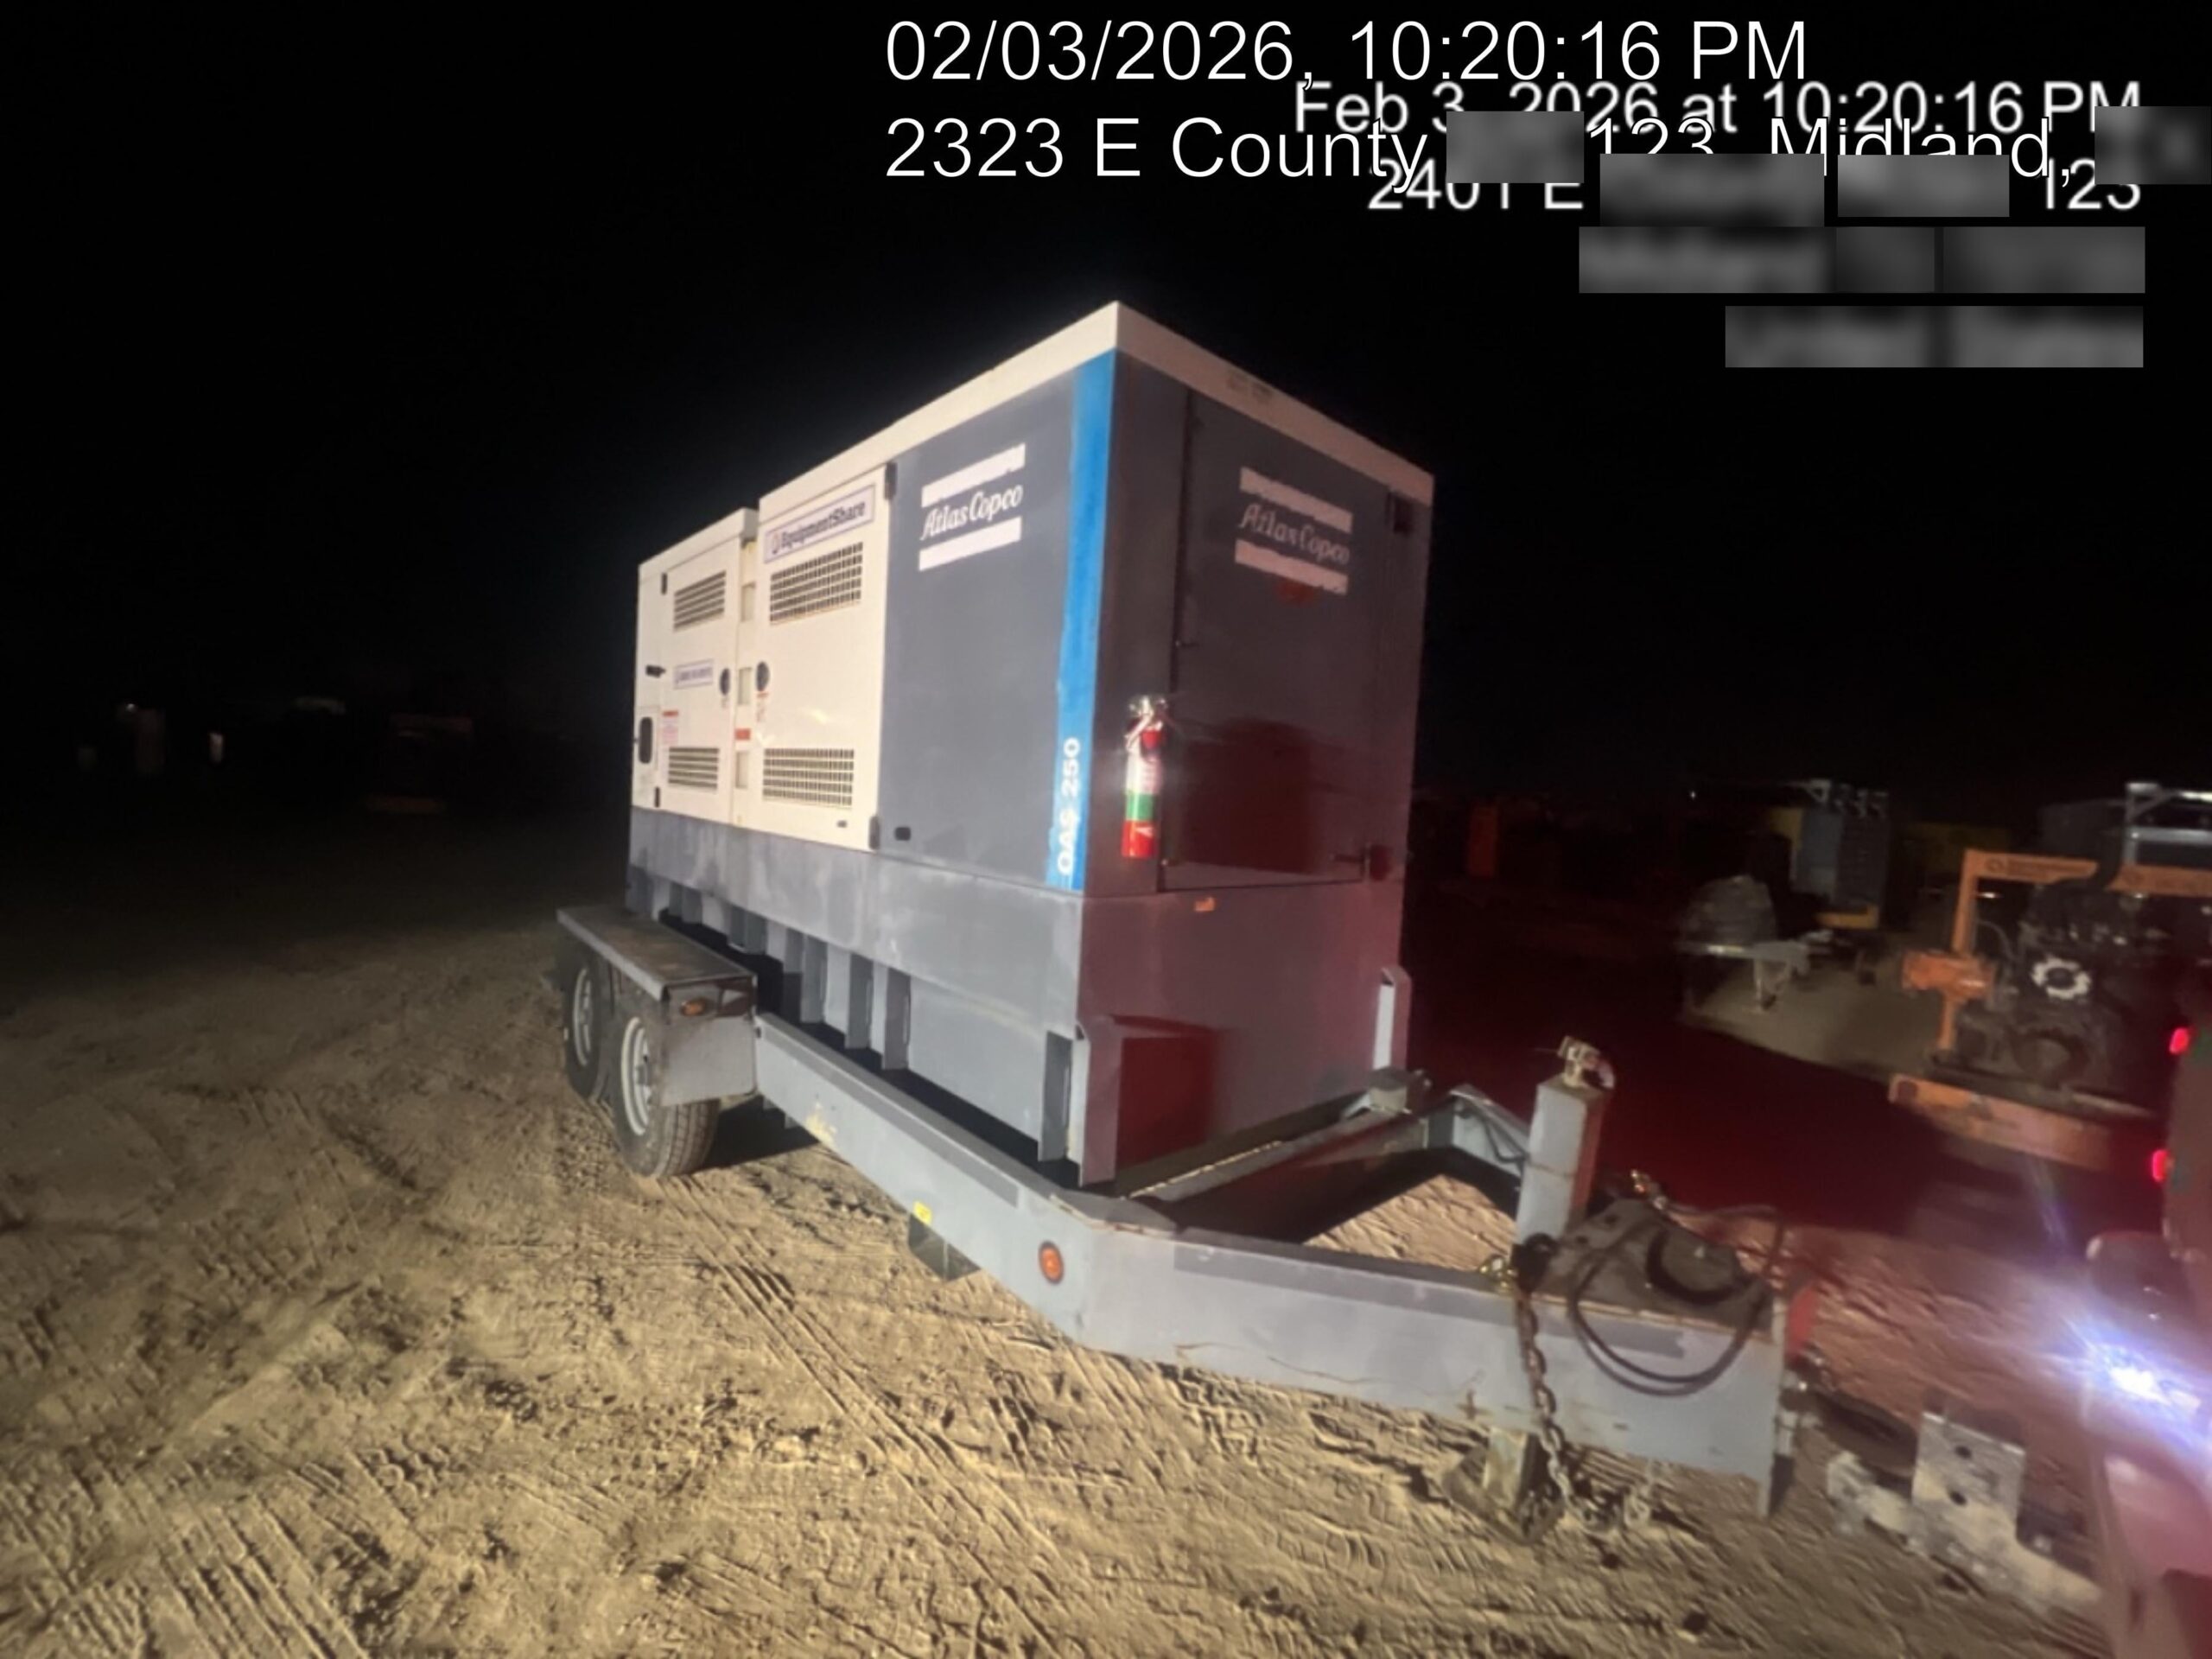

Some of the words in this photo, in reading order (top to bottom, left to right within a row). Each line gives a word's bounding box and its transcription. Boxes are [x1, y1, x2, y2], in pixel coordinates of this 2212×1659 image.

[919, 505, 969, 541] Atlas
[969, 485, 1024, 523] Copco
[1239, 502, 1297, 545] Atlas
[1299, 524, 1351, 566] Copco
[1060, 736, 1081, 798] 250
